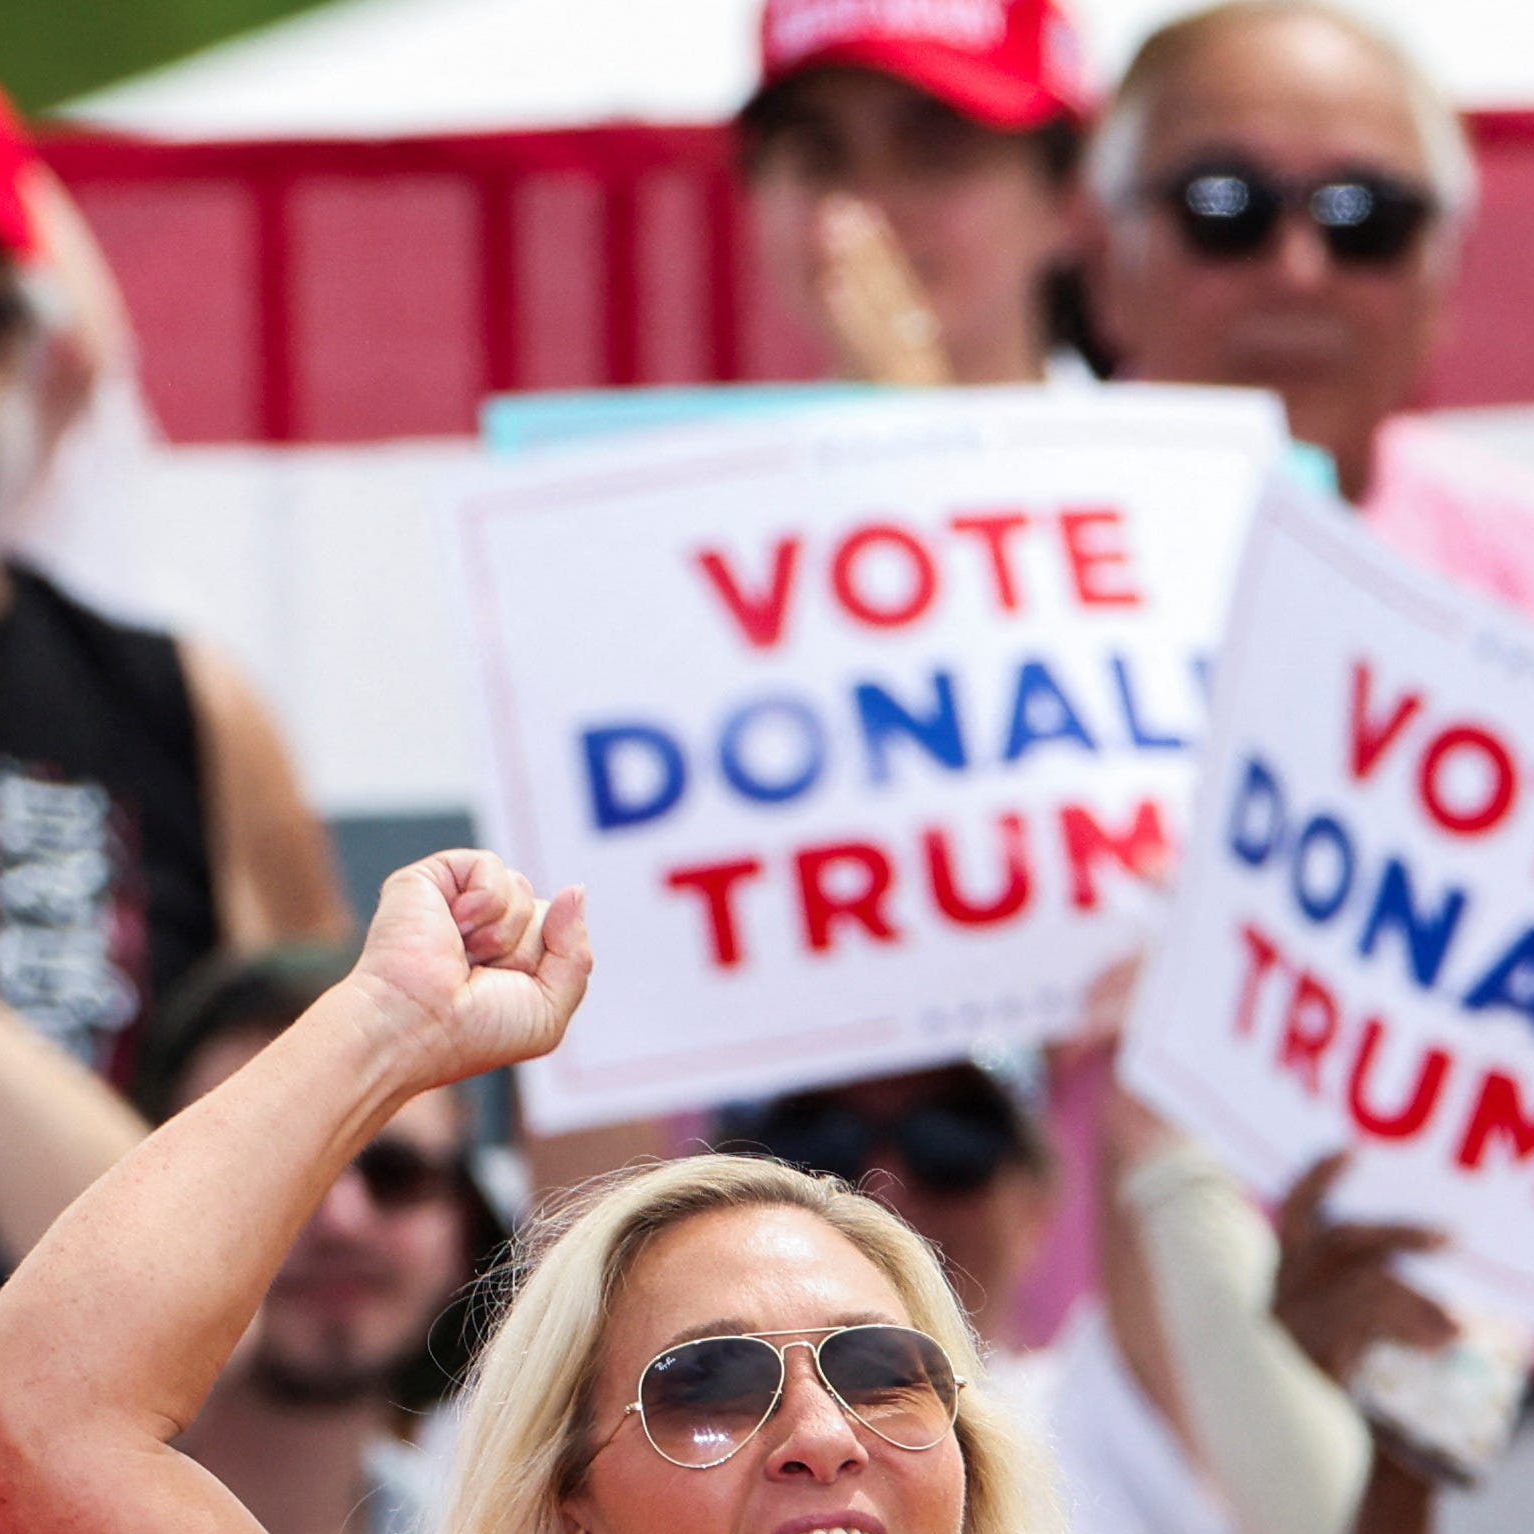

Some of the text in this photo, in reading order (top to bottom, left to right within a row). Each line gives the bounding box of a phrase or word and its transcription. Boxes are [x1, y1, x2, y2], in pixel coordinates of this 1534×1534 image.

[695, 508, 1141, 651] VOTE
[579, 652, 1215, 834] DONAL
[667, 797, 1173, 972] TRUM
